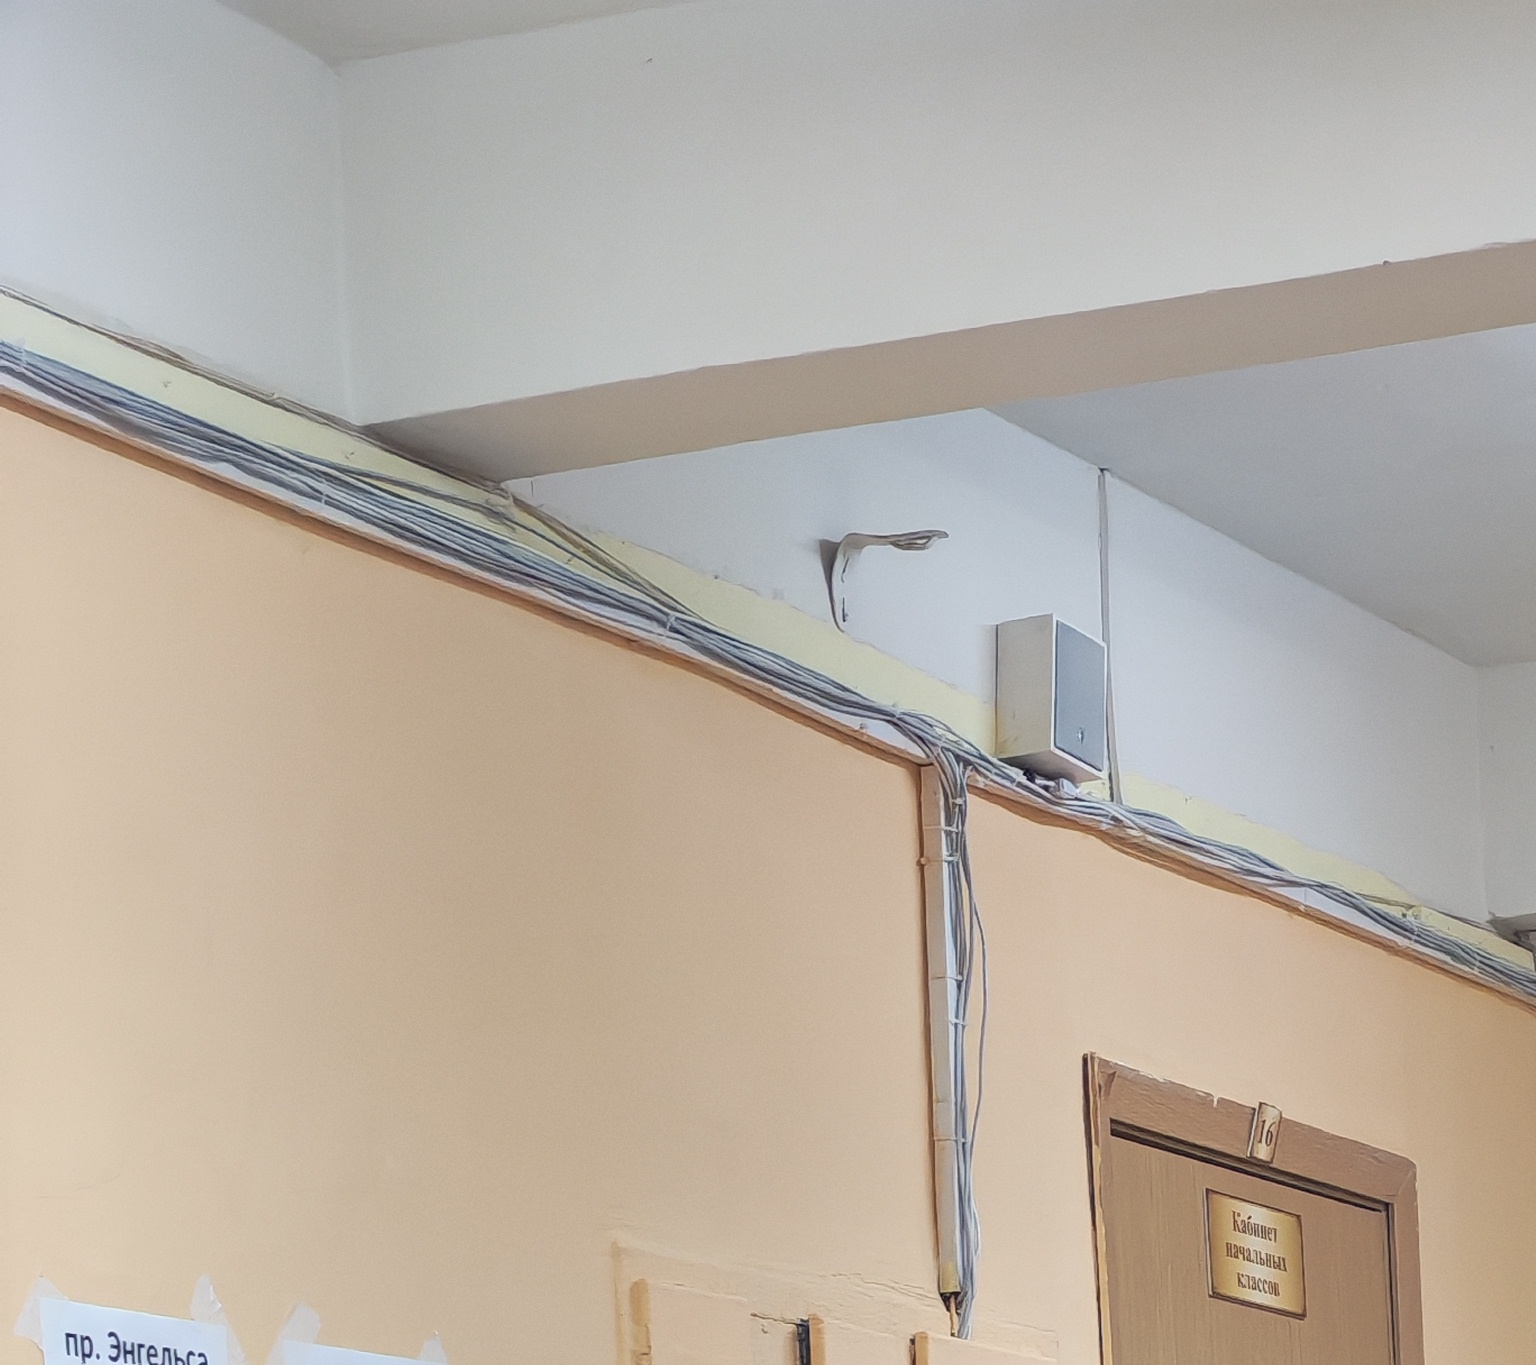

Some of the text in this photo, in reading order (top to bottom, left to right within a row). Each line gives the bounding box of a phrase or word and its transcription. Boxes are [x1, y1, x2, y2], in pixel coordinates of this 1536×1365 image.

[1257, 1119, 1277, 1146] 16
[1231, 1210, 1278, 1243] Кабинет
[1225, 1241, 1288, 1273] начальных
[1236, 1271, 1280, 1297] классов
[64, 1331, 101, 1365] пр.
